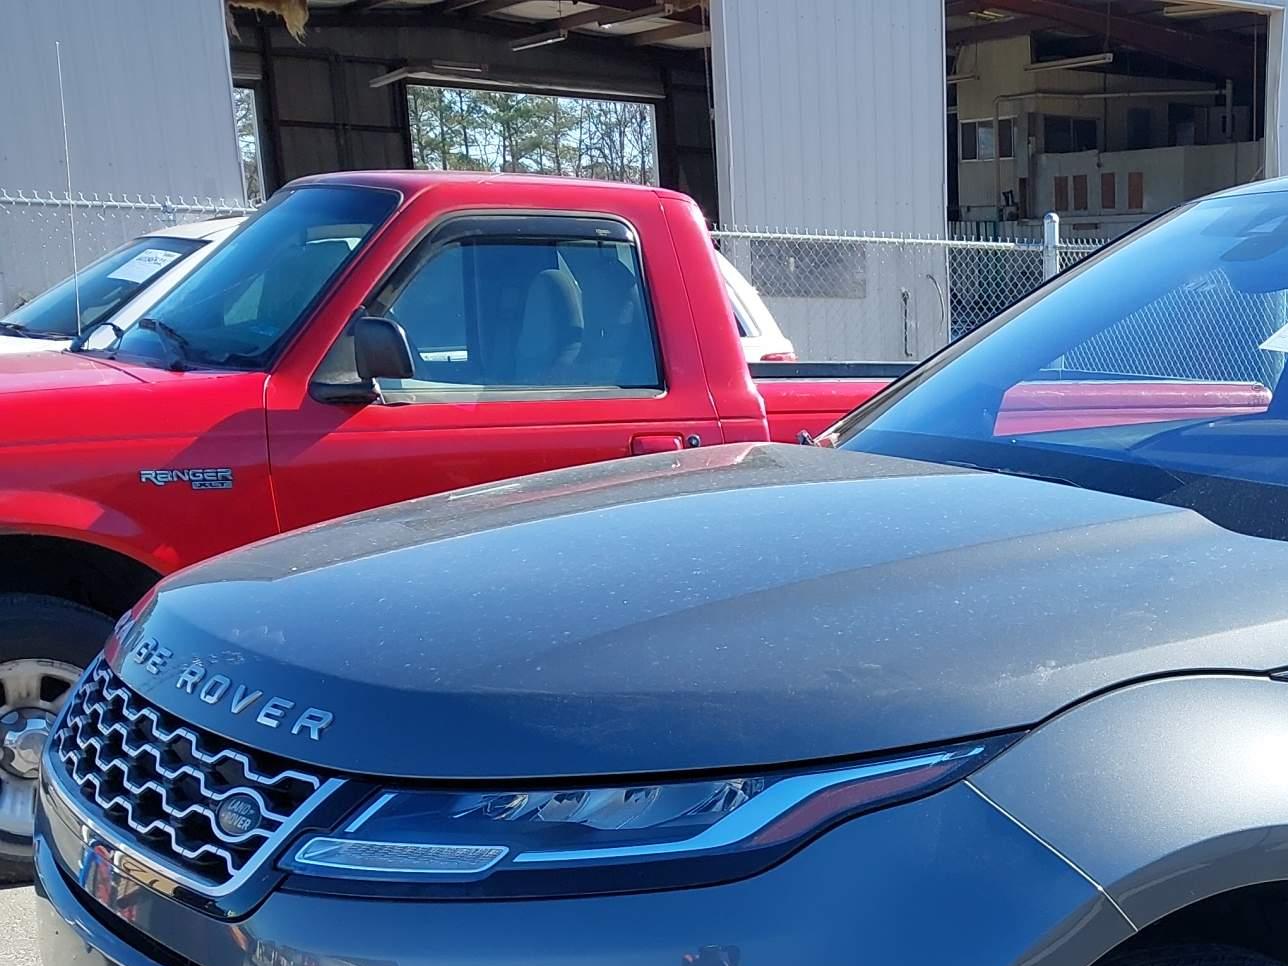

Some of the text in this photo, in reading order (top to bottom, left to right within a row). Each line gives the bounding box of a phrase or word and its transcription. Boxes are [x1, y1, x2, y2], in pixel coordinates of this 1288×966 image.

[141, 469, 232, 485] RANGER
[176, 664, 334, 741] ROVER
[227, 799, 251, 815] LAND
